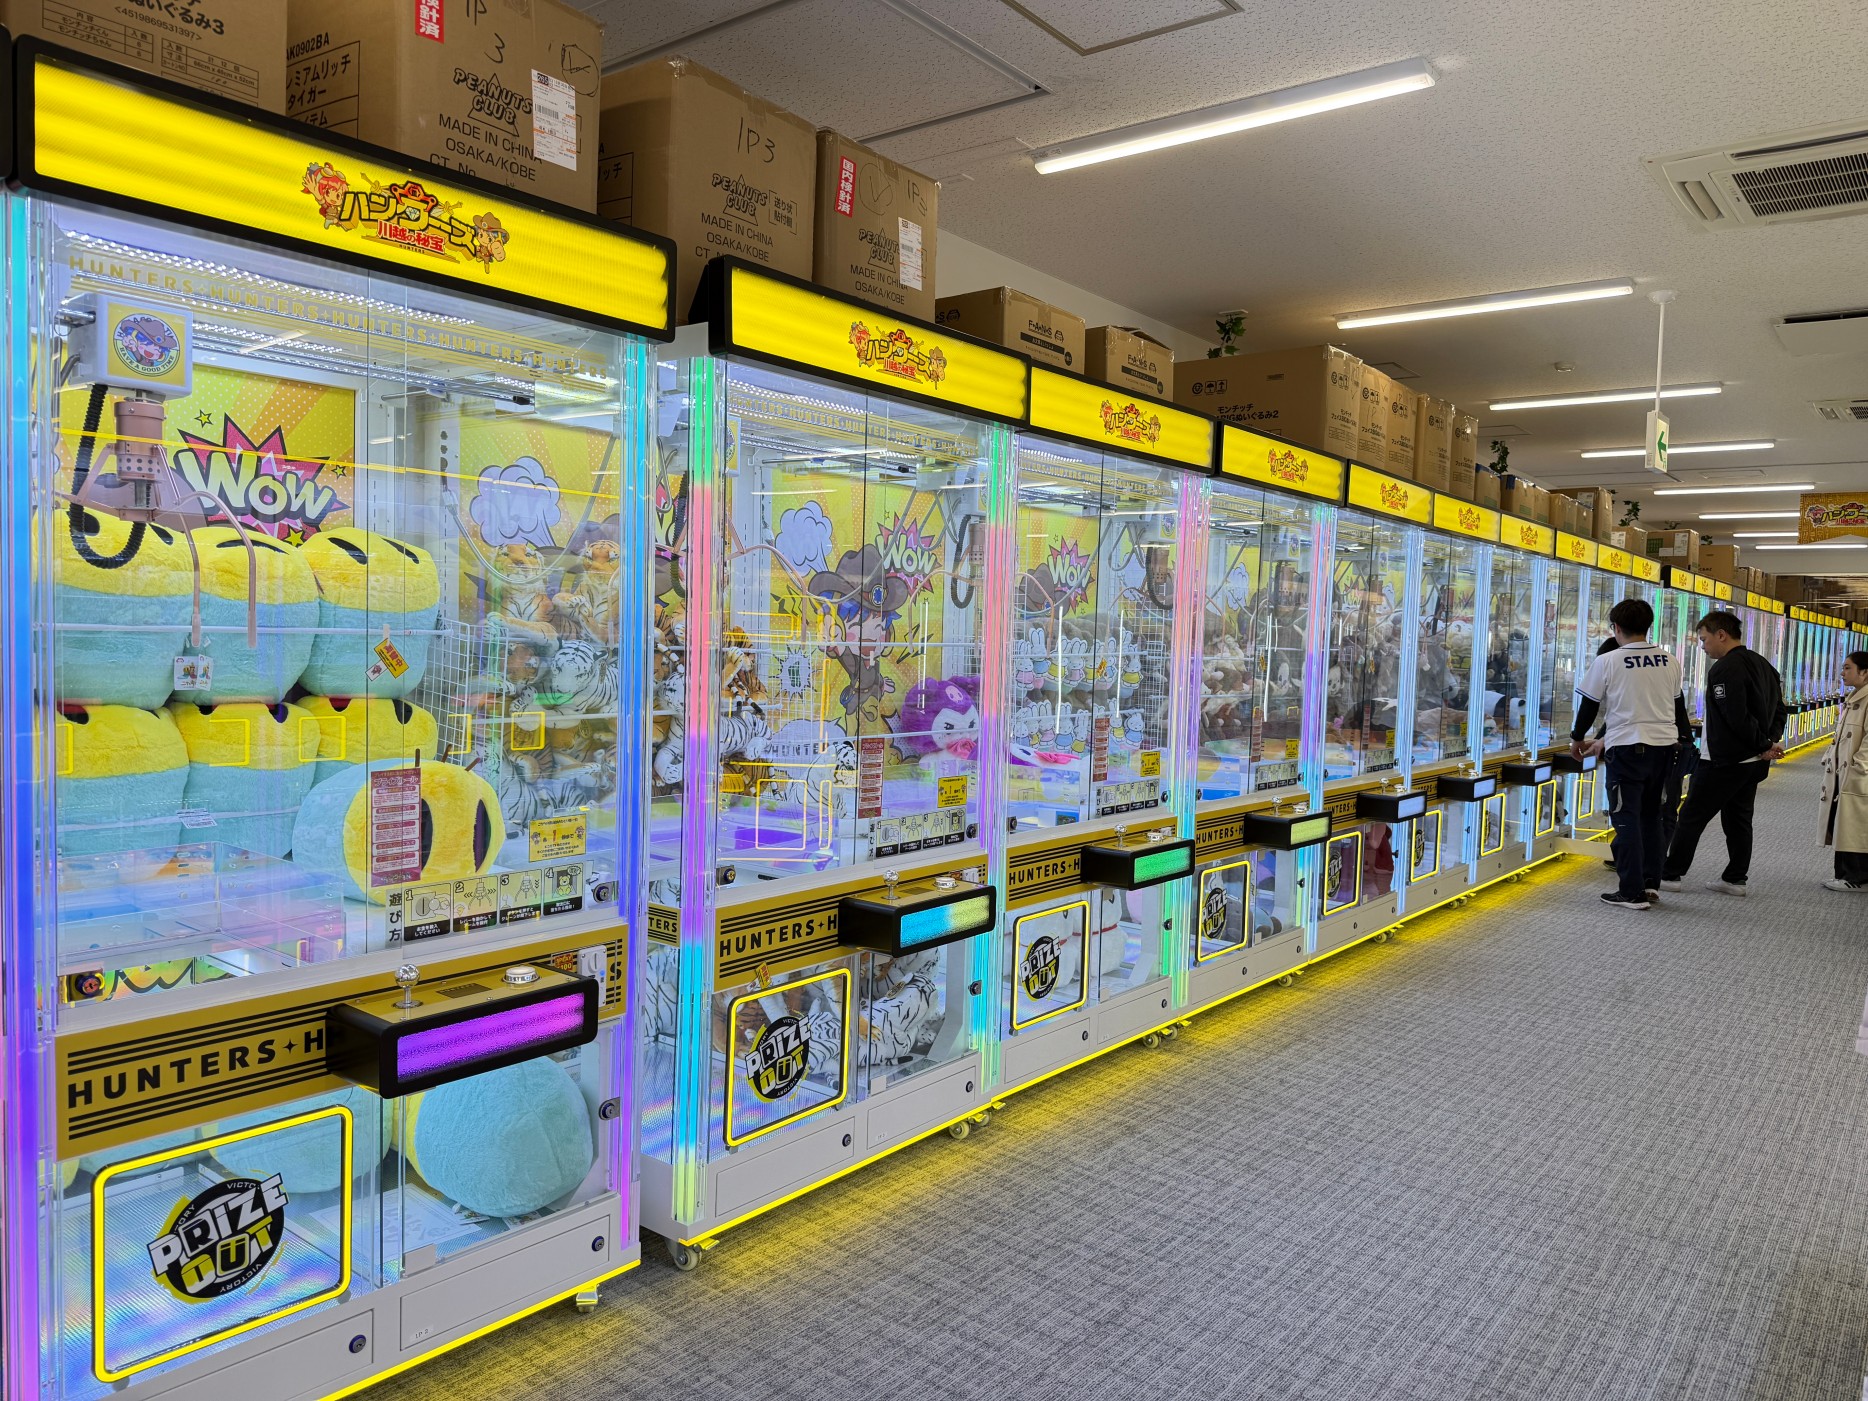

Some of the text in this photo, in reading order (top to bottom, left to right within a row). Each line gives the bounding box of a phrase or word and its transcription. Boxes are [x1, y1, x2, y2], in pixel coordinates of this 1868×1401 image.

[76, 12, 94, 23] 内容
[288, 85, 326, 110] タイガー
[453, 67, 533, 115] PEANUTS
[471, 95, 517, 126] CLUB
[439, 113, 481, 139] MADE
[485, 130, 498, 148] IN
[446, 137, 537, 182] OSAKA/KOBE
[712, 172, 768, 207] PEANUTS
[726, 193, 757, 217] CLUB
[339, 188, 478, 259] ハンターズ
[377, 219, 445, 254] 川越の秘宝
[701, 212, 774, 248] MADE IN CHINA
[695, 246, 711, 259] CT
[706, 231, 769, 262] OSAKA/KOBE
[858, 228, 900, 255] PEANUT
[870, 245, 895, 266] CLUB
[850, 264, 876, 280] MADE
[877, 272, 886, 283] IN
[69, 255, 194, 294] HUNTERS
[209, 286, 319, 319] HUNTERS
[332, 310, 428, 343] HUNTERS
[439, 332, 523, 362] HUNTERS
[855, 280, 905, 306] OSAKA/KOBE
[119, 347, 135, 366] HAVE
[161, 355, 175, 370] TIME
[173, 448, 337, 523] WOW
[875, 533, 937, 575] WOW
[1623, 654, 1669, 669] STAFF
[1196, 828, 1234, 844] HUNTERS
[454, 880, 464, 893] 2
[545, 867, 555, 878] 4
[1008, 860, 1066, 886] HUNTERS
[405, 889, 414, 901] 1
[388, 892, 402, 942] 遊び方
[719, 919, 815, 958] HUNTERS
[1019, 936, 1062, 983] PRIZE
[745, 1015, 812, 1080] PRIZE
[68, 1039, 276, 1110] HUNTERS
[760, 1045, 805, 1095] OUT
[226, 1181, 260, 1190] VICTO
[147, 1172, 289, 1278] PRIZE
[181, 1215, 274, 1294] OUT
[219, 1263, 263, 1293] VICTORY
